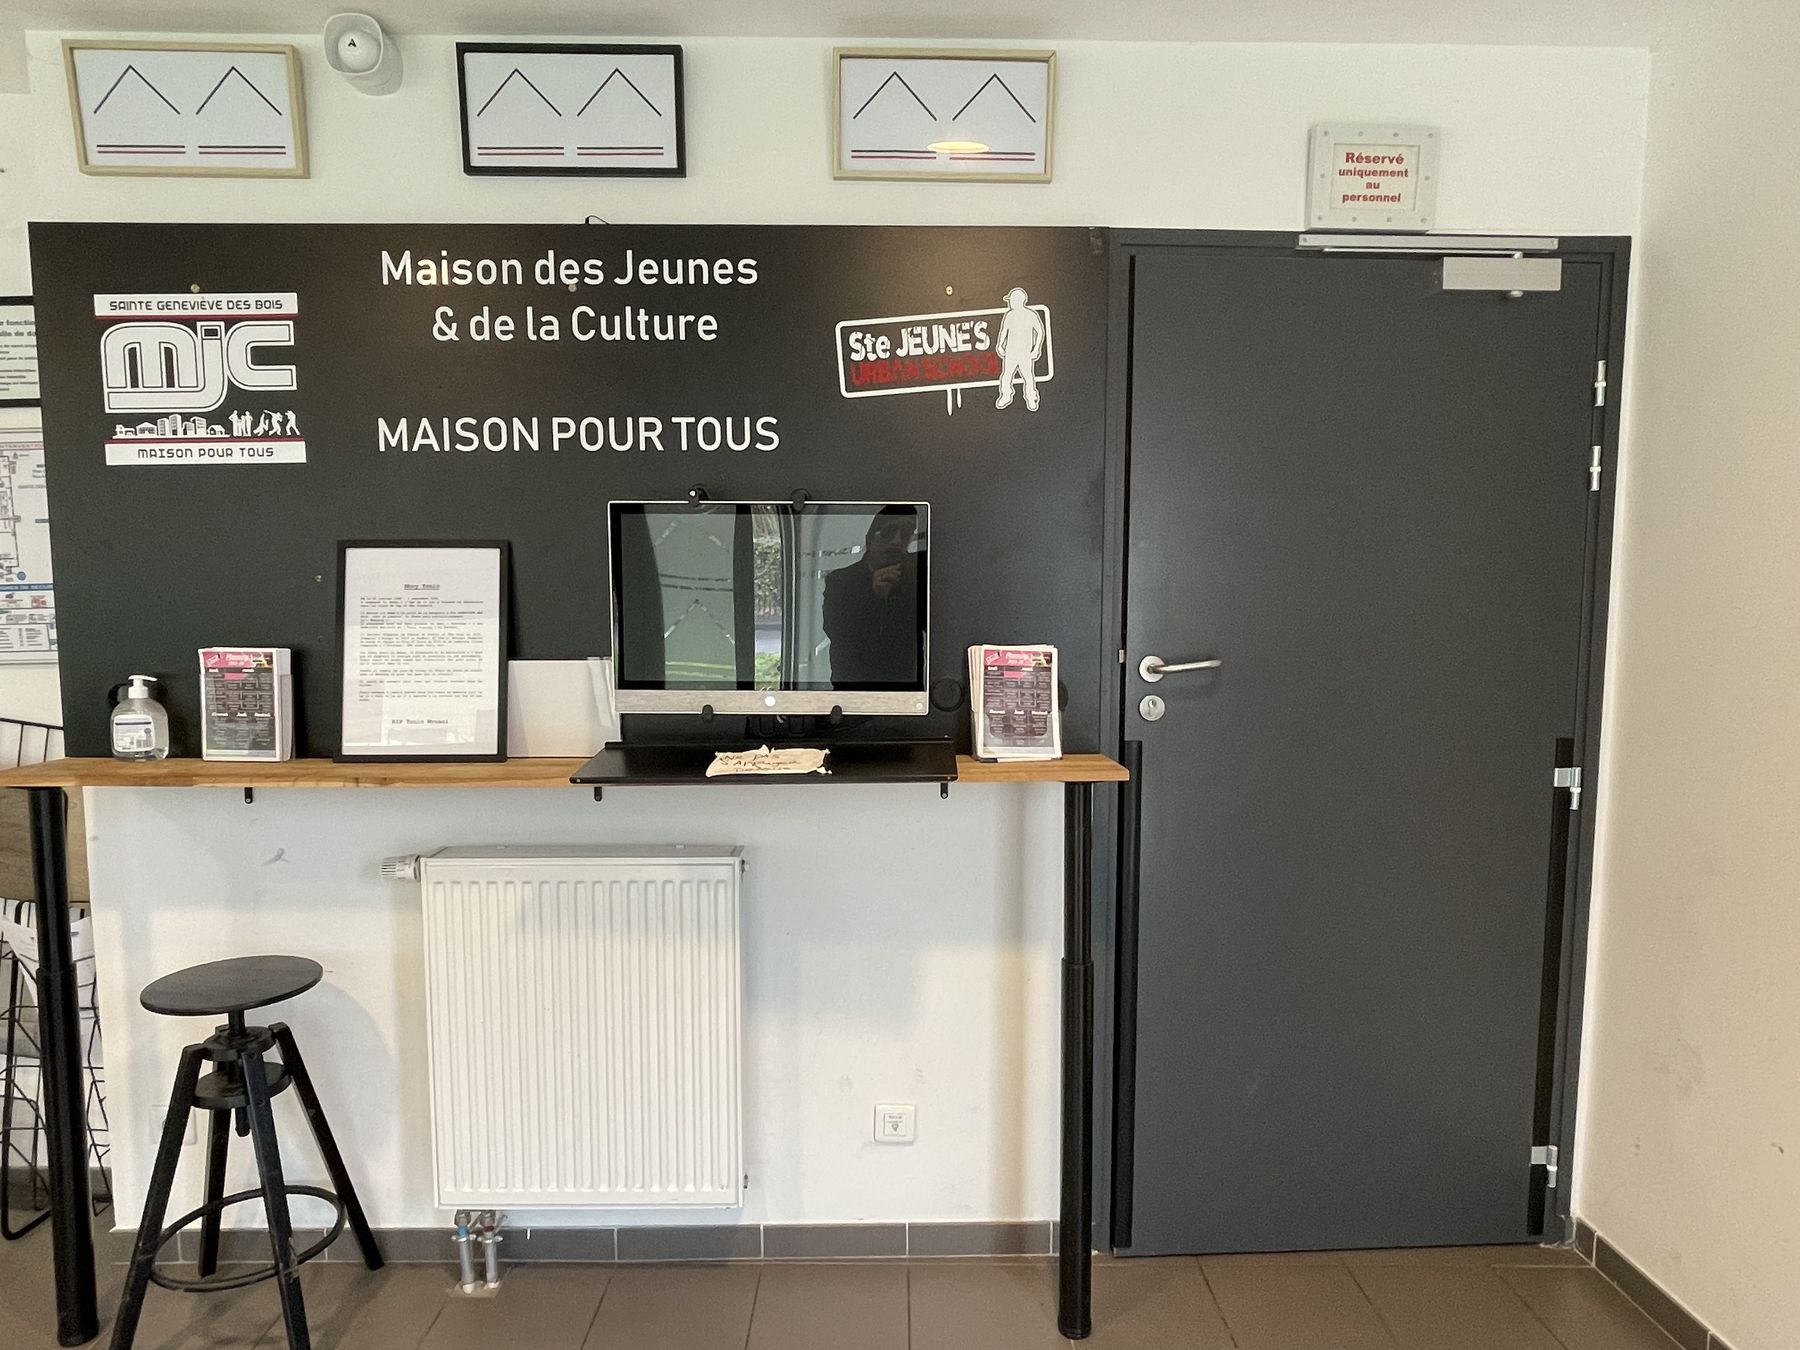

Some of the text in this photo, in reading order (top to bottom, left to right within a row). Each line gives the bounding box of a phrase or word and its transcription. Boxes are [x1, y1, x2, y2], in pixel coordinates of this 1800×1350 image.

[1345, 151, 1404, 165] Réservé
[1339, 167, 1408, 178] uniquement
[1365, 182, 1380, 190] au
[1342, 193, 1401, 203] personnel
[381, 249, 758, 286] Maison des Jeunes
[110, 297, 283, 311] SAINTE GENEVIÈVE DES BOIS
[432, 305, 718, 342] & de la Culture
[849, 331, 891, 362] Ste
[377, 416, 780, 452] MAISON POUR TOUS
[138, 447, 274, 459] MAISON POUR TOUS
